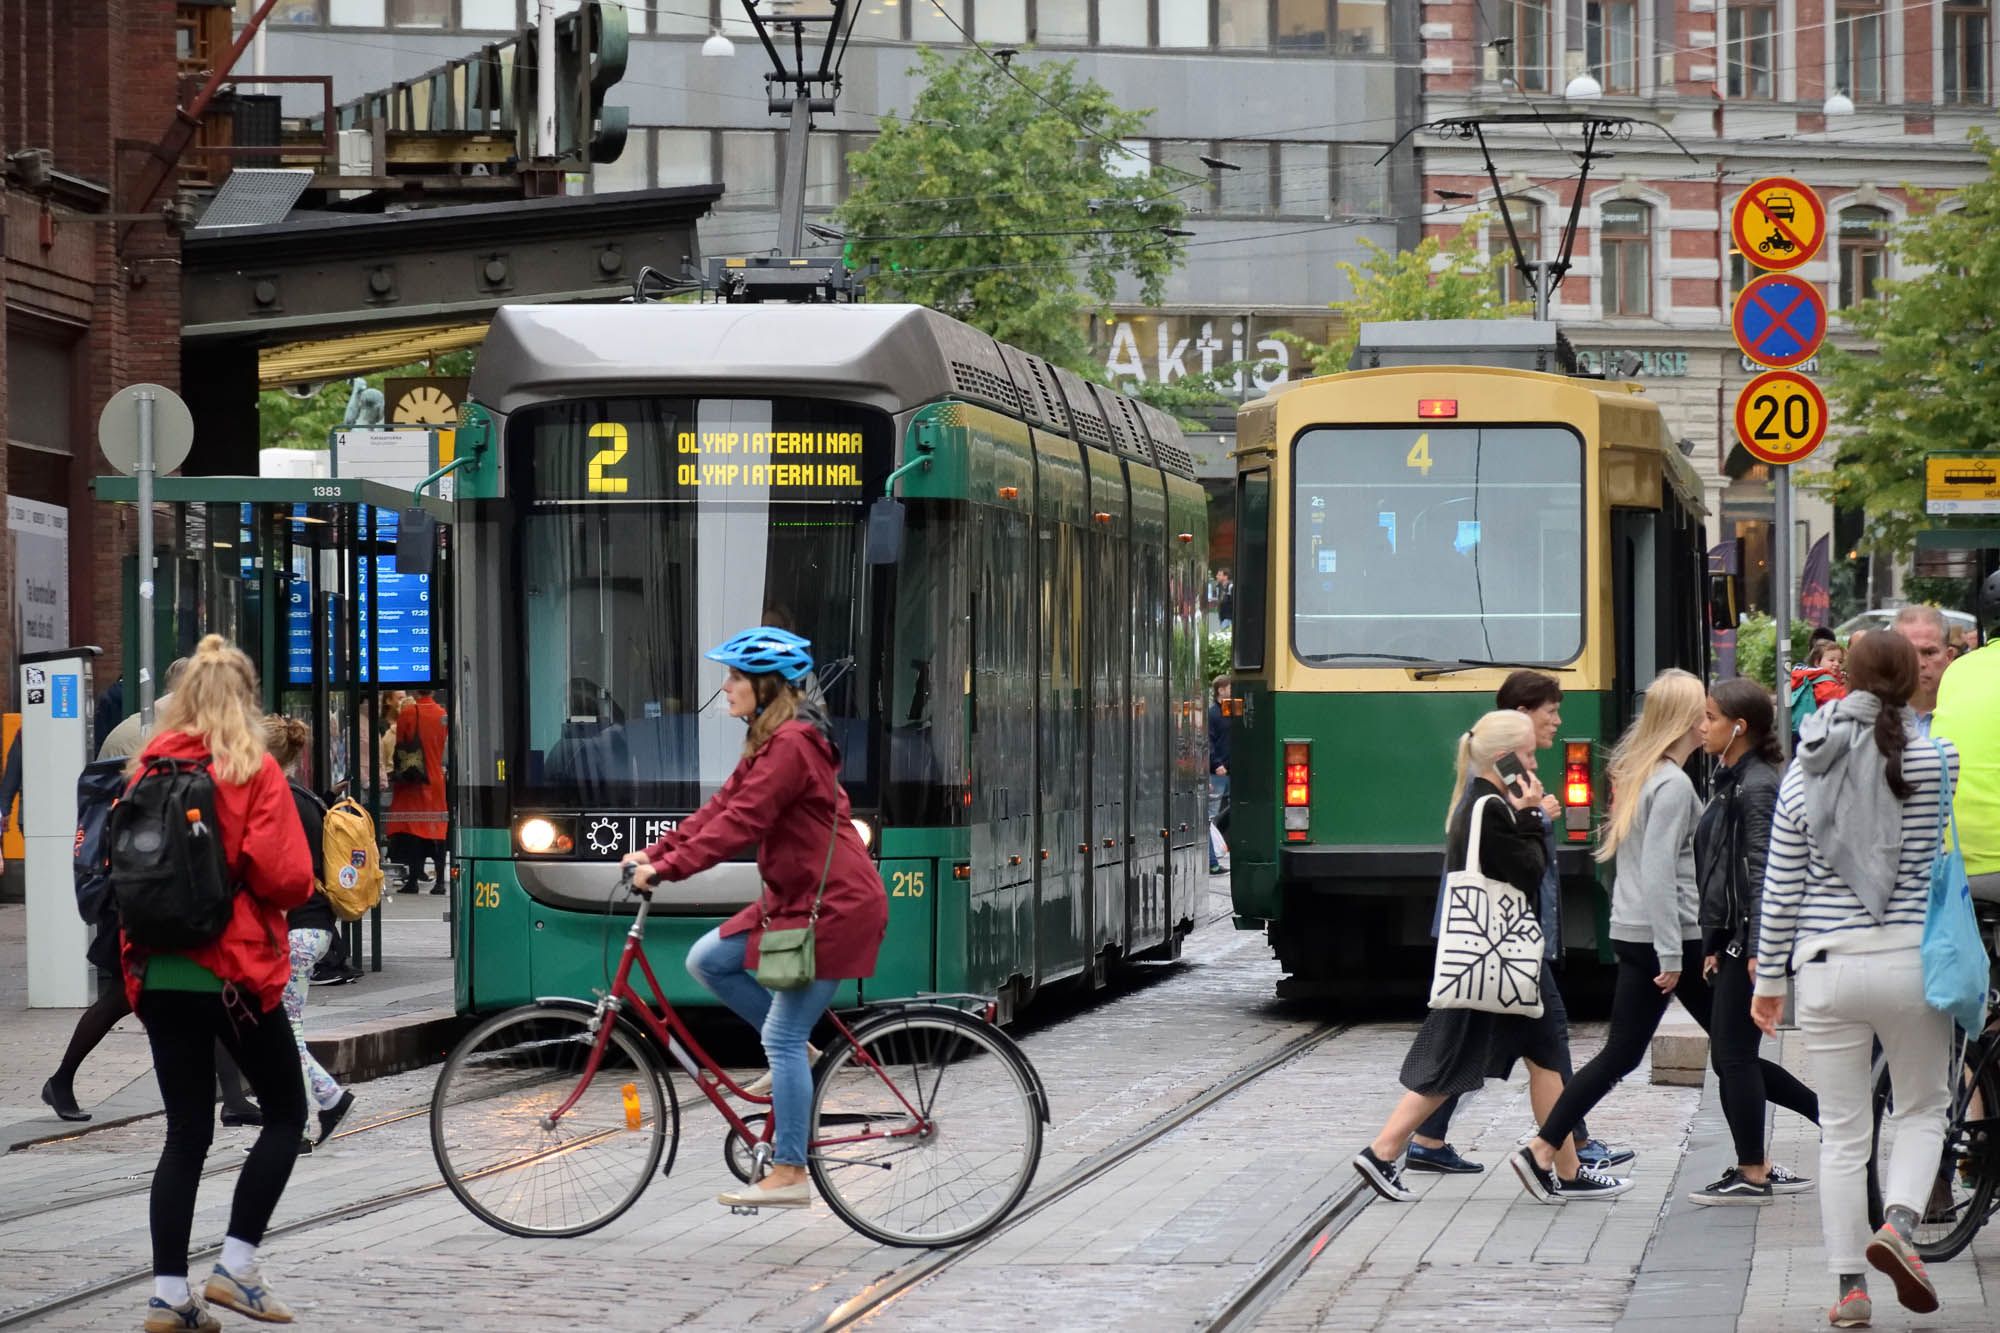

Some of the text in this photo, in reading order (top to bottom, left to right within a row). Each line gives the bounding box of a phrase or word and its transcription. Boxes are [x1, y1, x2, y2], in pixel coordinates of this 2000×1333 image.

[1106, 321, 1289, 394] Aktia
[1754, 394, 1809, 440] 20
[338, 434, 346, 445] 4
[678, 432, 863, 454] OLYMPIATERMINAA
[588, 422, 628, 493] 2
[1407, 432, 1432, 476] 4
[678, 464, 863, 486] OLYMPIATERMINAL
[312, 486, 341, 497] 1383
[419, 574, 428, 583] 0
[420, 591, 428, 602] 6
[476, 881, 500, 908] 215
[892, 871, 924, 898] 215
